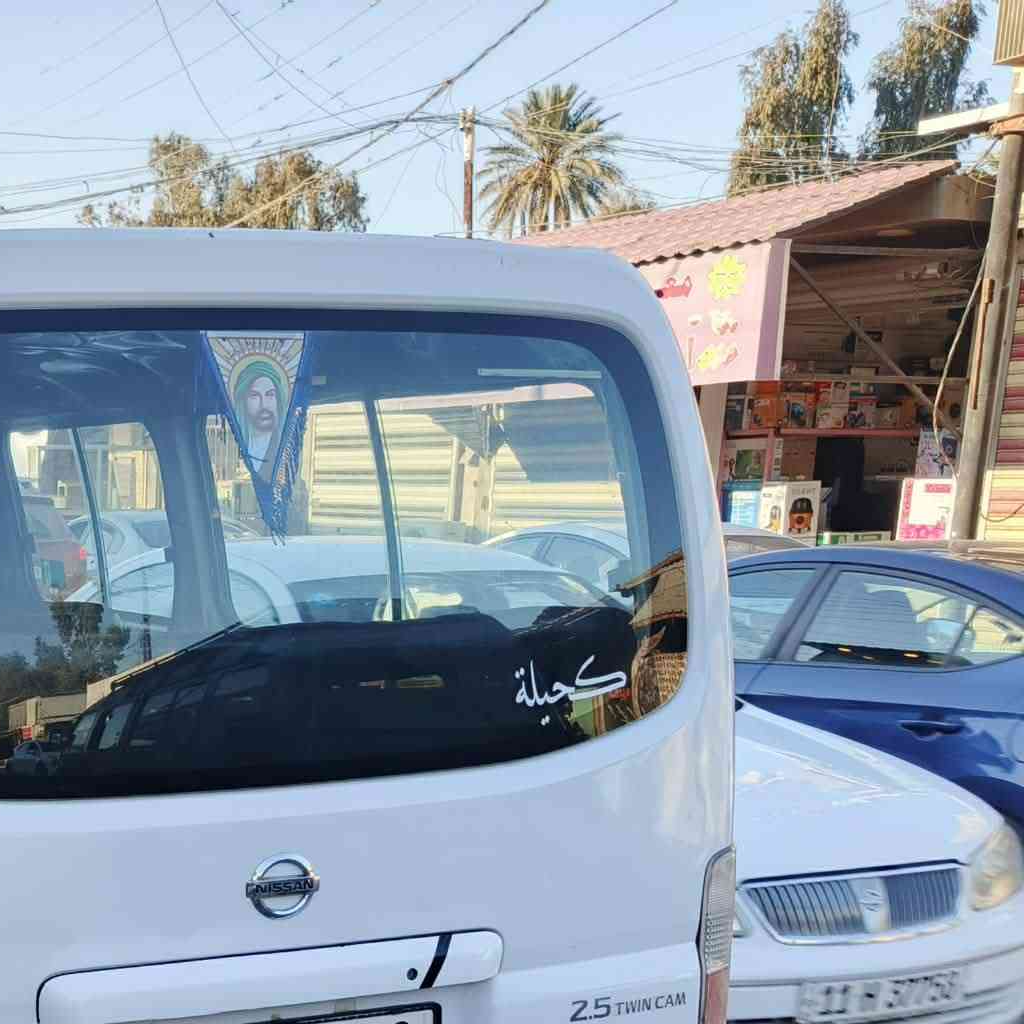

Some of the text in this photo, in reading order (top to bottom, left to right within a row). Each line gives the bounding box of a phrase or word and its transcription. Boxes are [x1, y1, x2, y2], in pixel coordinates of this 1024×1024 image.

[514, 654, 627, 726] كحيلة
[255, 878, 315, 894] NISSAN
[569, 991, 687, 1022] 2.5 TWIN CAM
